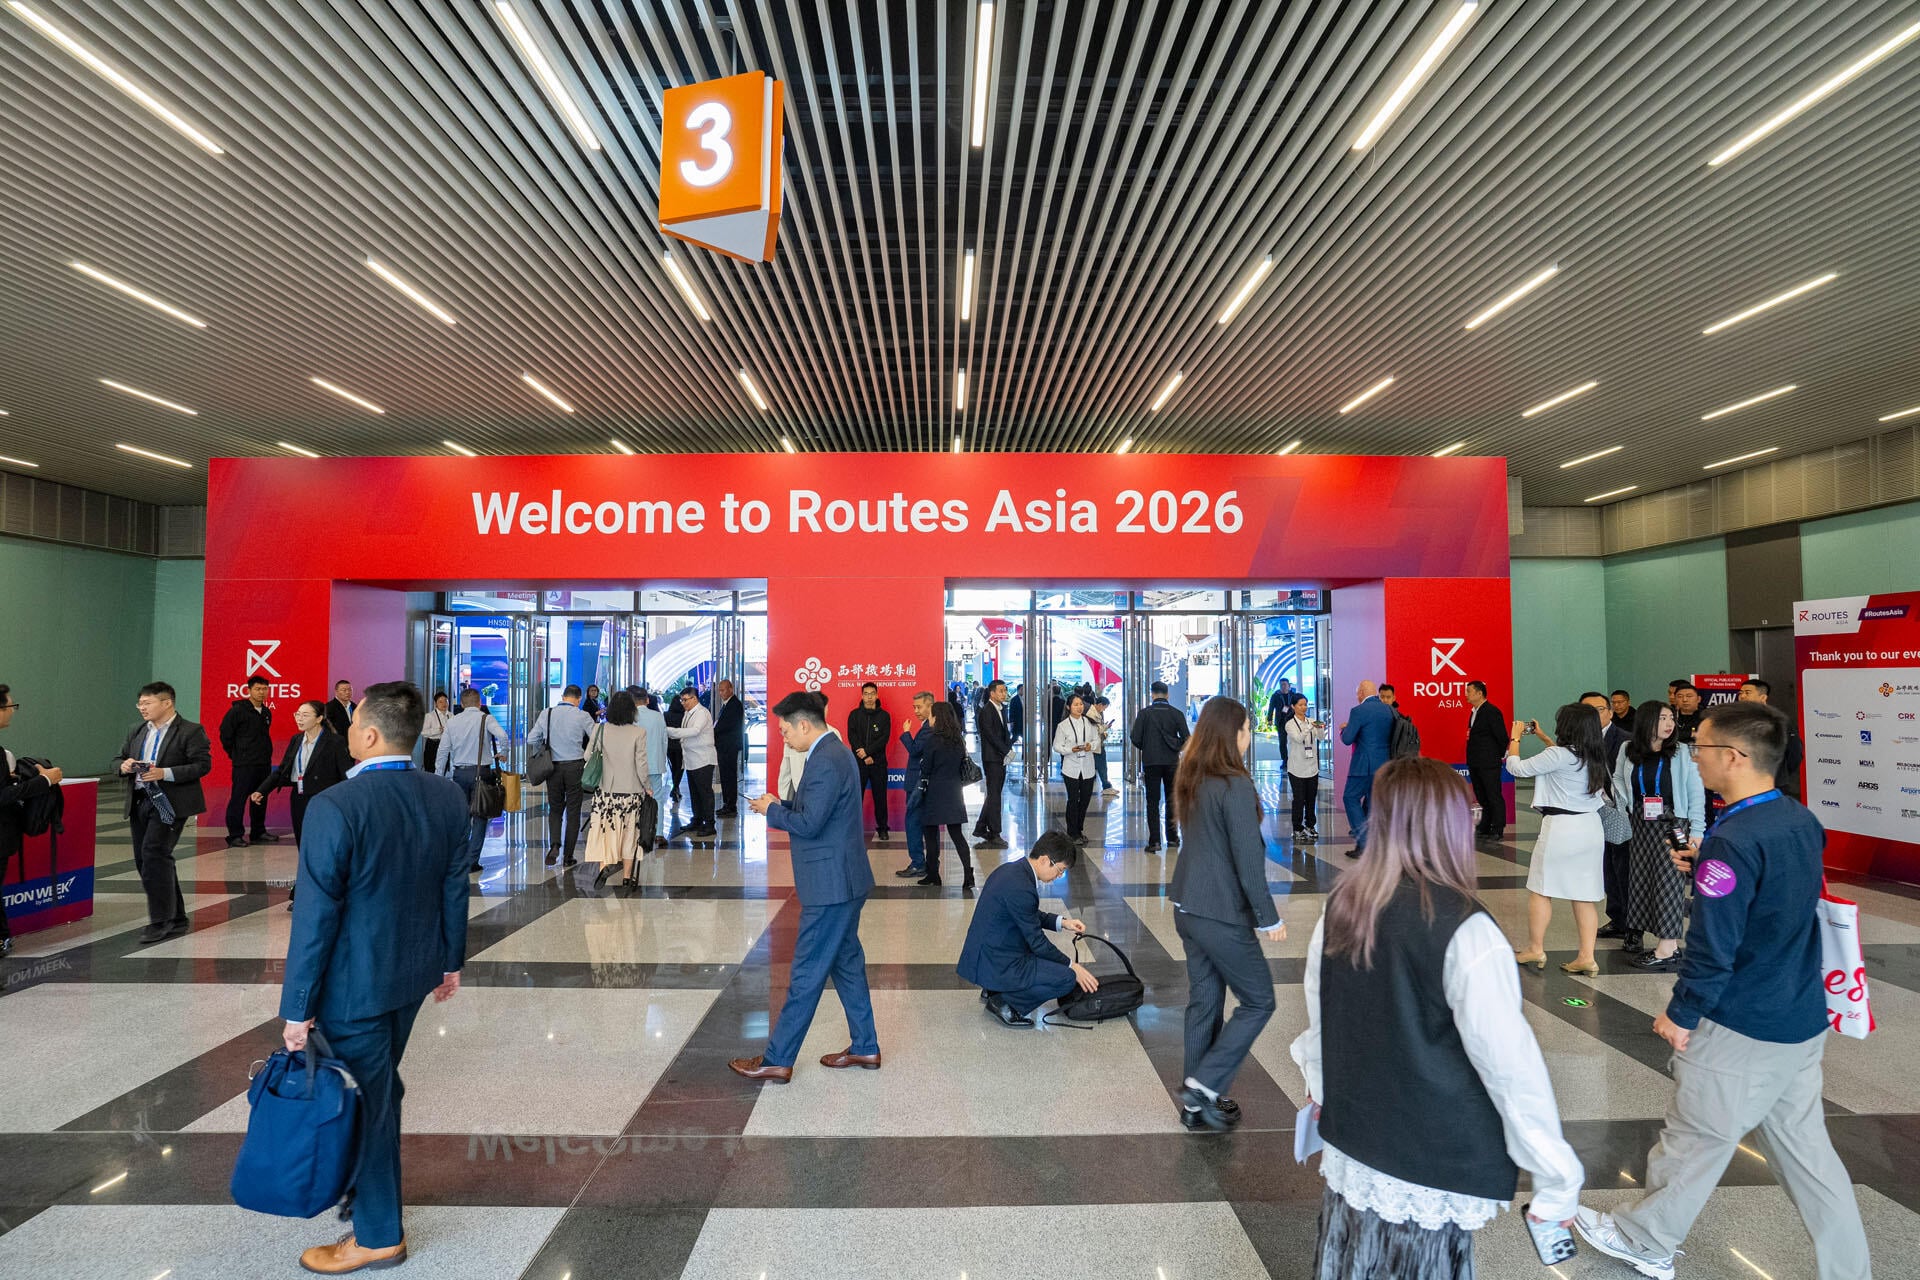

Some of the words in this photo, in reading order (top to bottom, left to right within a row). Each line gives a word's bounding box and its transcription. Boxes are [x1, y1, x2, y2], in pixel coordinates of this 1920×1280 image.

[679, 100, 734, 188] 3
[472, 490, 705, 535] Welcome
[721, 493, 770, 534] to
[790, 489, 968, 533] Routes
[985, 489, 1097, 533] Asia
[1116, 489, 1243, 533] 2026
[1812, 611, 1848, 621] ROUTES
[1864, 609, 1903, 617] #RoutesAsia
[1809, 651, 1841, 662] Thank
[1844, 652, 1863, 663] you
[1866, 650, 1877, 660] to
[1881, 651, 1900, 660] our
[227, 683, 301, 698] ROTES
[1414, 682, 1487, 697] ROUT
[1438, 700, 1463, 708] ASIA
[1708, 693, 1736, 706] ATW
[888, 774, 905, 782] TION
[3, 890, 35, 907] TION
